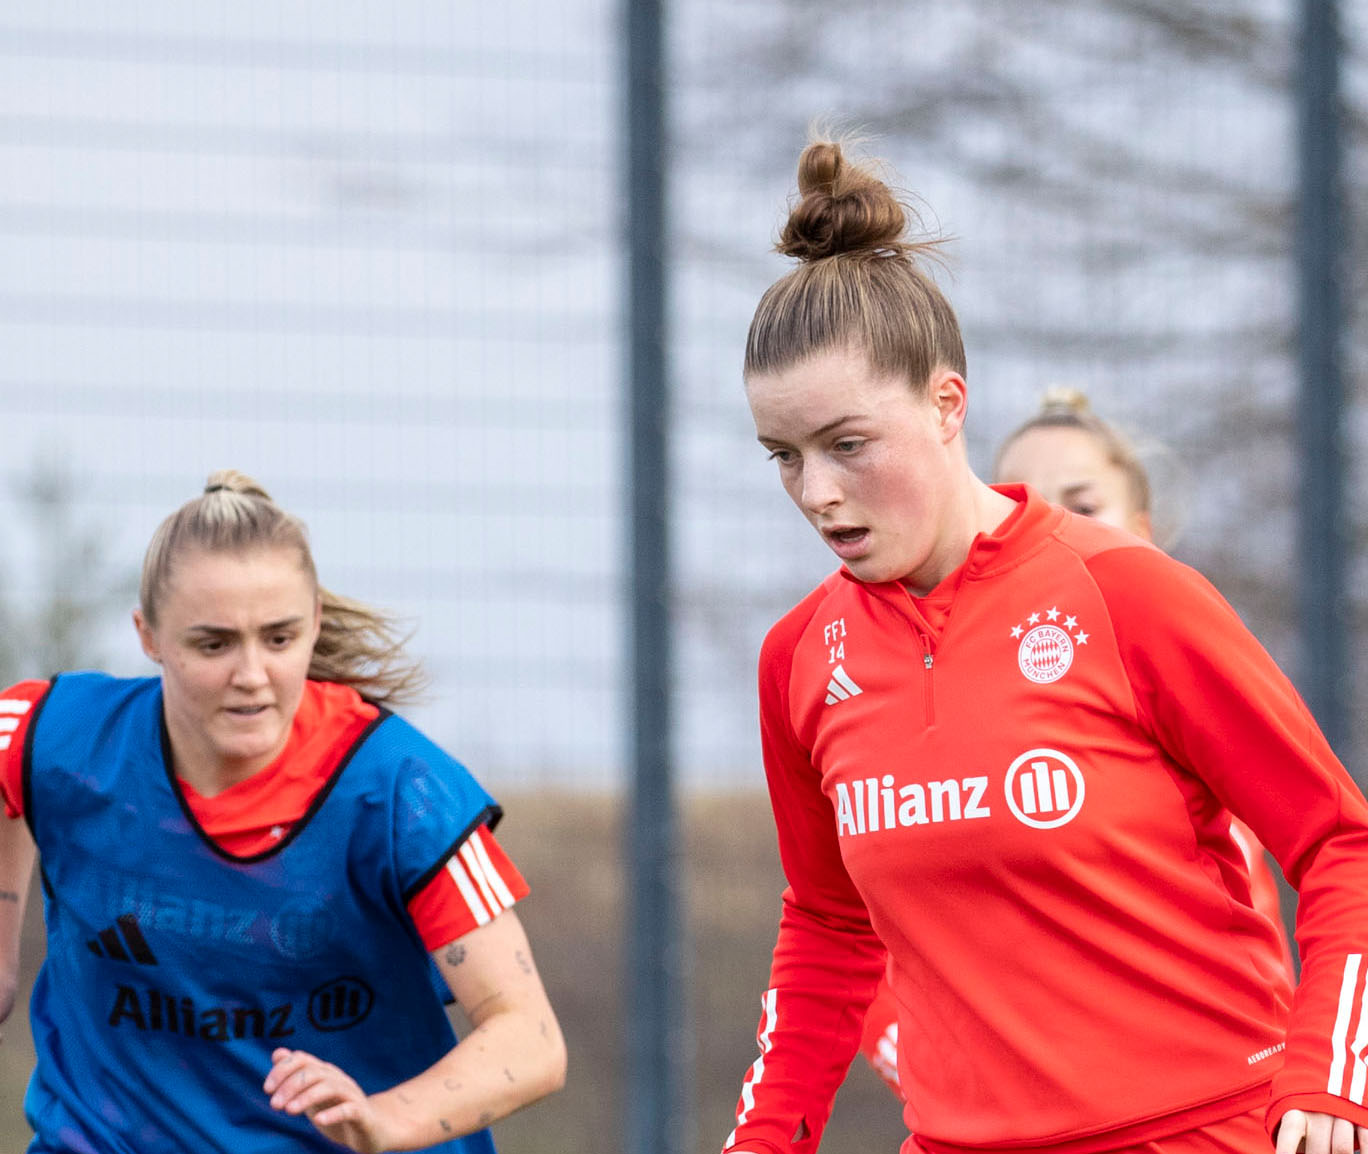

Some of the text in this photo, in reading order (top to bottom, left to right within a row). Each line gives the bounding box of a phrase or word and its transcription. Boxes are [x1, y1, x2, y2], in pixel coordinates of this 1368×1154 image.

[824, 618, 847, 645] FF1
[1026, 630, 1069, 652] FC BAYERN
[828, 641, 845, 664] 14
[835, 774, 991, 837] Allianz
[108, 983, 295, 1043] Allianz
